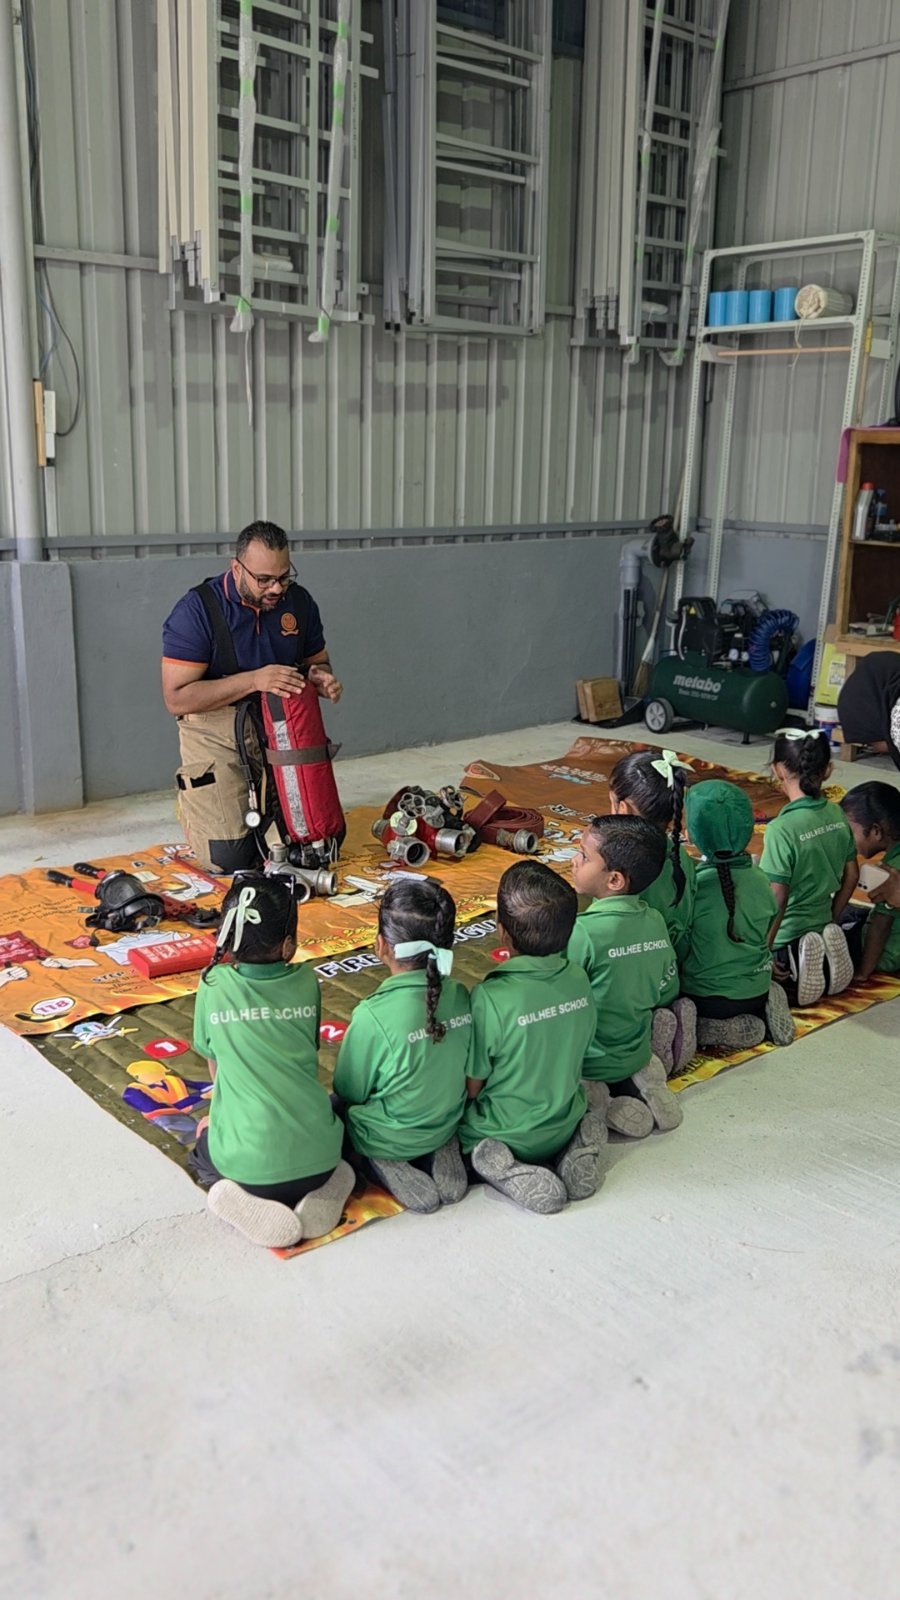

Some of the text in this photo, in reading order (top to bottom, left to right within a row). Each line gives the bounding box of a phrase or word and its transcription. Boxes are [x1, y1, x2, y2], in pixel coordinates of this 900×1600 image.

[673, 674, 722, 693] metabo
[608, 939, 669, 958] GULHEE SCHOOL
[314, 953, 384, 978] FIRE
[36, 1000, 70, 1013] 118
[209, 1005, 317, 1025] GULHEE SCHOO
[517, 997, 589, 1027] GULHEE SCHOOL
[450, 1013, 472, 1029] SCHO
[320, 1024, 344, 1038] 2
[154, 1041, 178, 1053] 1
